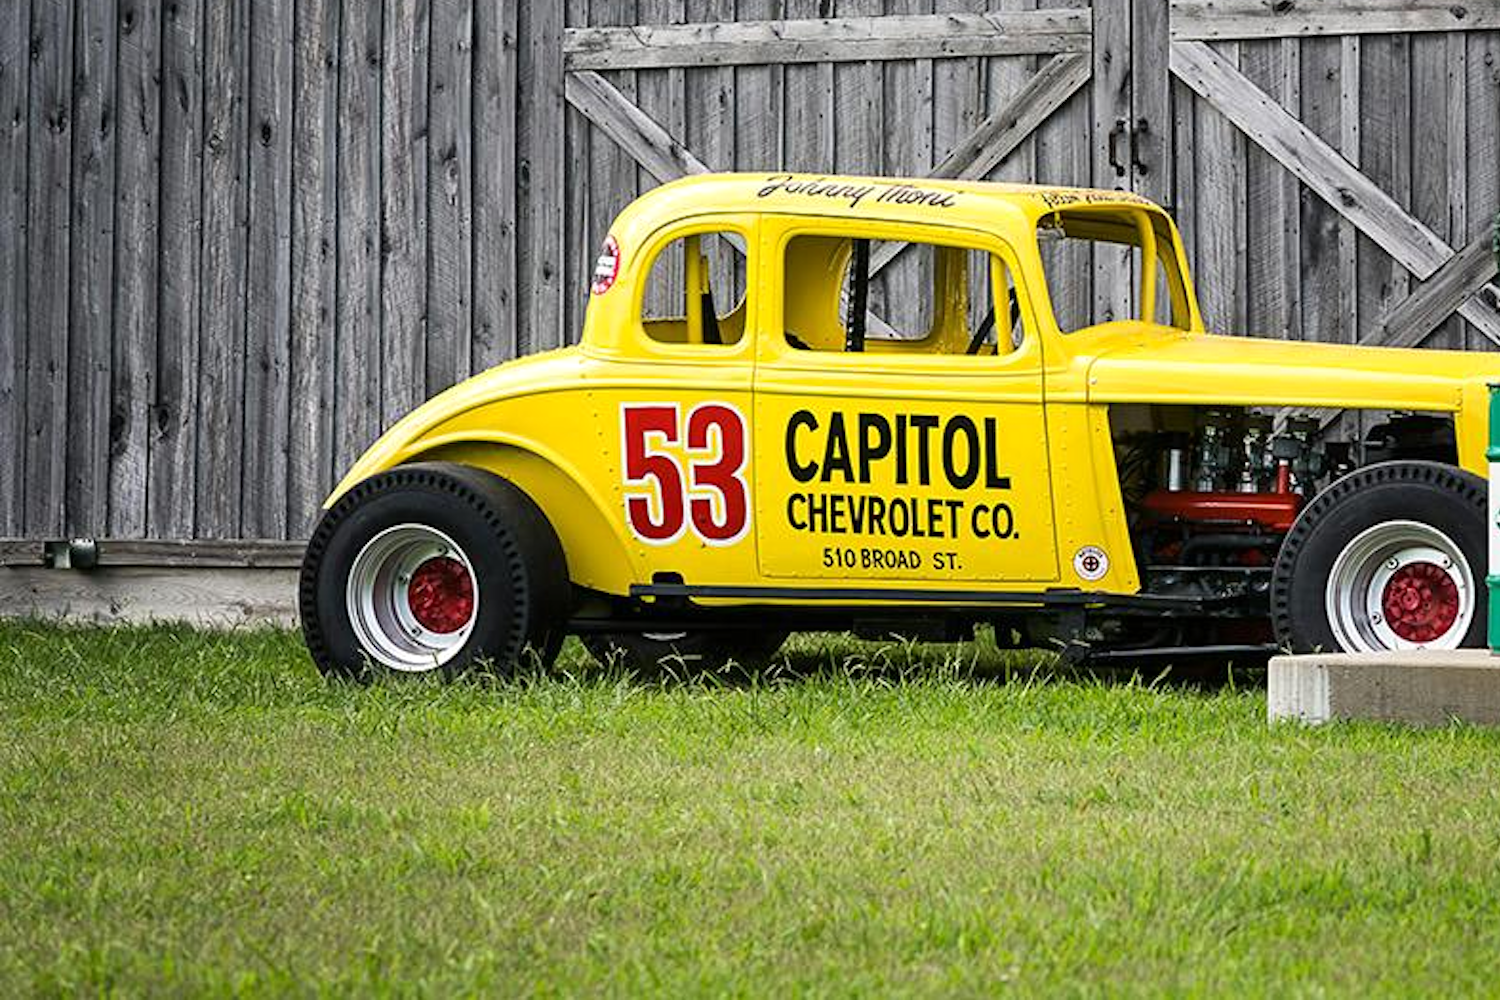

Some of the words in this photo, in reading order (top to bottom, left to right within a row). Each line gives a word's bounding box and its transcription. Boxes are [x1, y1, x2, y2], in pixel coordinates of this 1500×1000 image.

[622, 403, 749, 544] 53
[785, 409, 1011, 490] CAPITOL
[787, 493, 964, 539] CHEVROLET
[971, 503, 1020, 540] CO.
[822, 547, 856, 568] 510
[860, 548, 921, 570] BROAD
[932, 549, 962, 570] ST.
